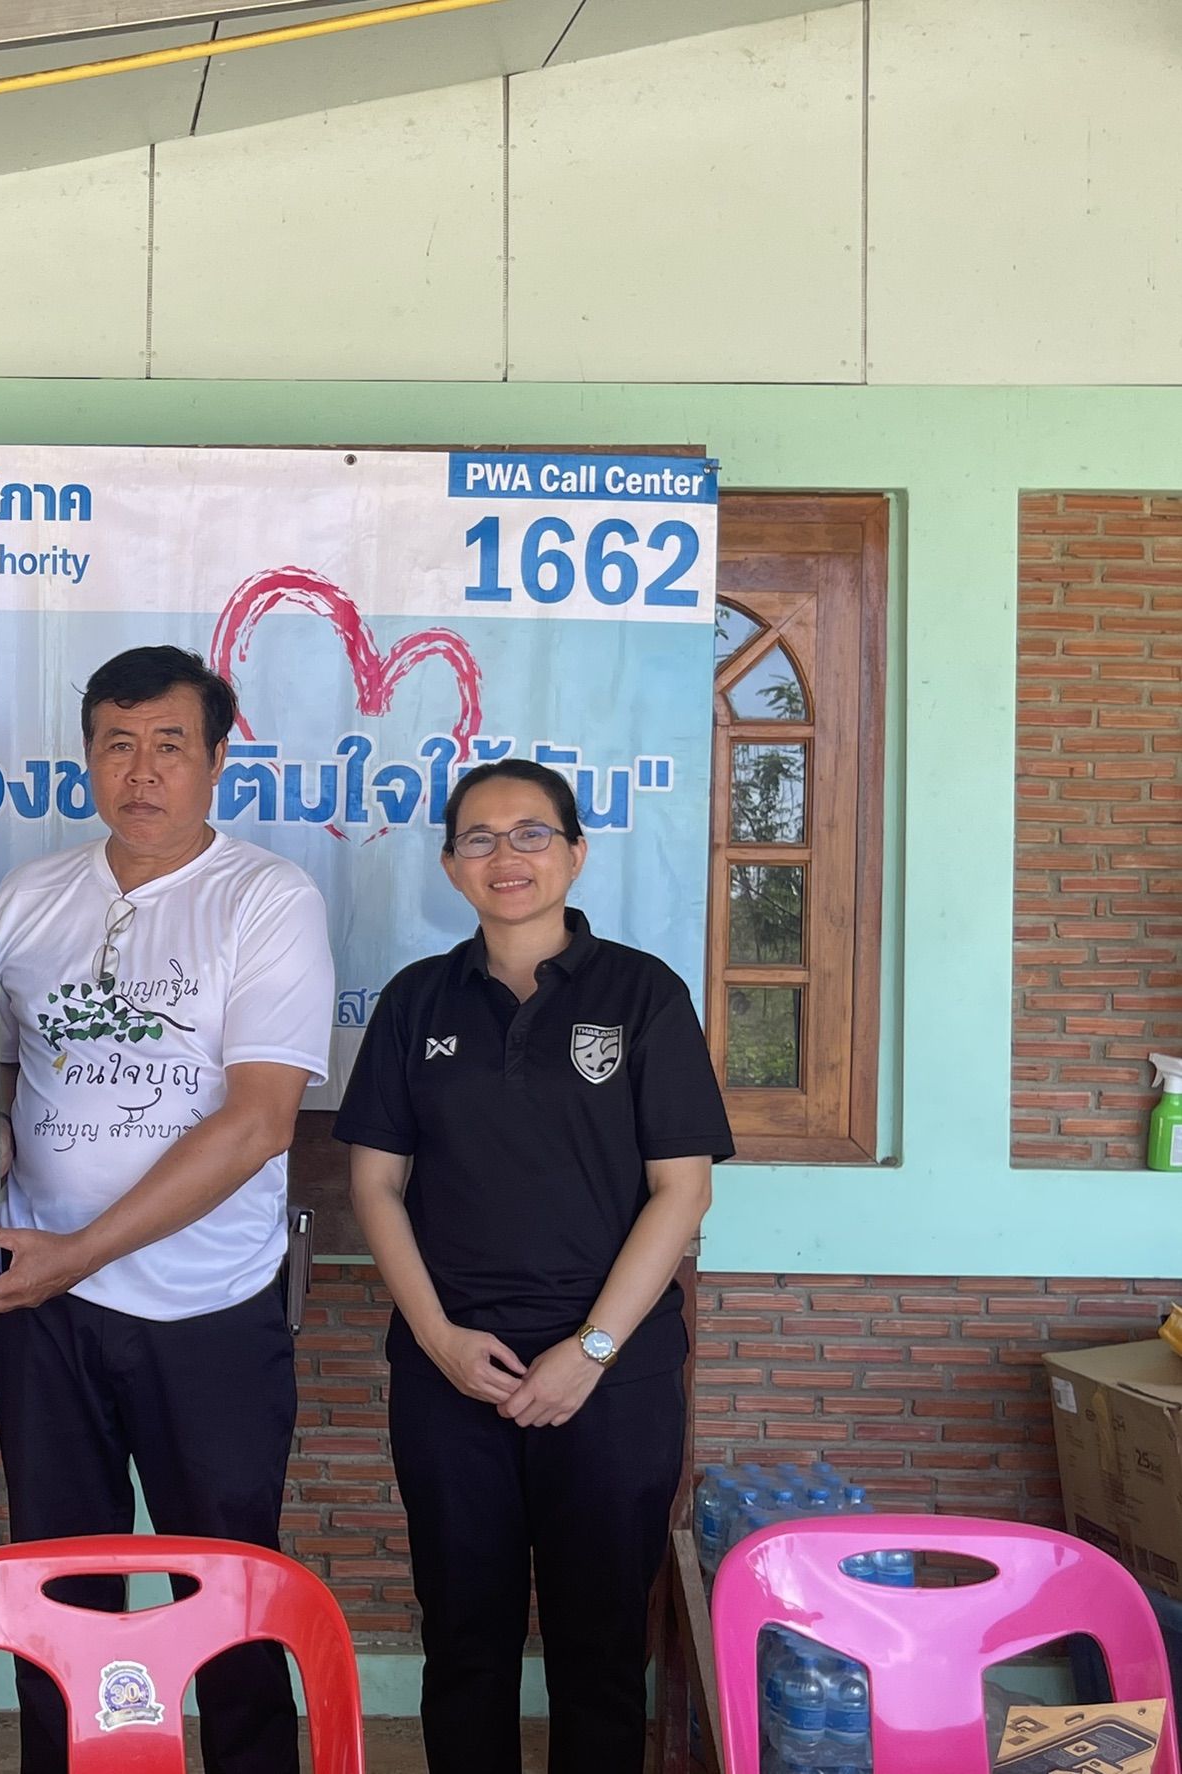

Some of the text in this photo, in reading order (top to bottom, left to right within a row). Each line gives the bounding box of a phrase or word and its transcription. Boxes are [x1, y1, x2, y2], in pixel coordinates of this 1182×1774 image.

[466, 463, 704, 496] PWA Call Center
[464, 516, 700, 607] 1662
[577, 1028, 618, 1037] THAILAND
[65, 1053, 201, 1110] คนใจบุญ
[34, 1109, 99, 1152] สร้างบุญ
